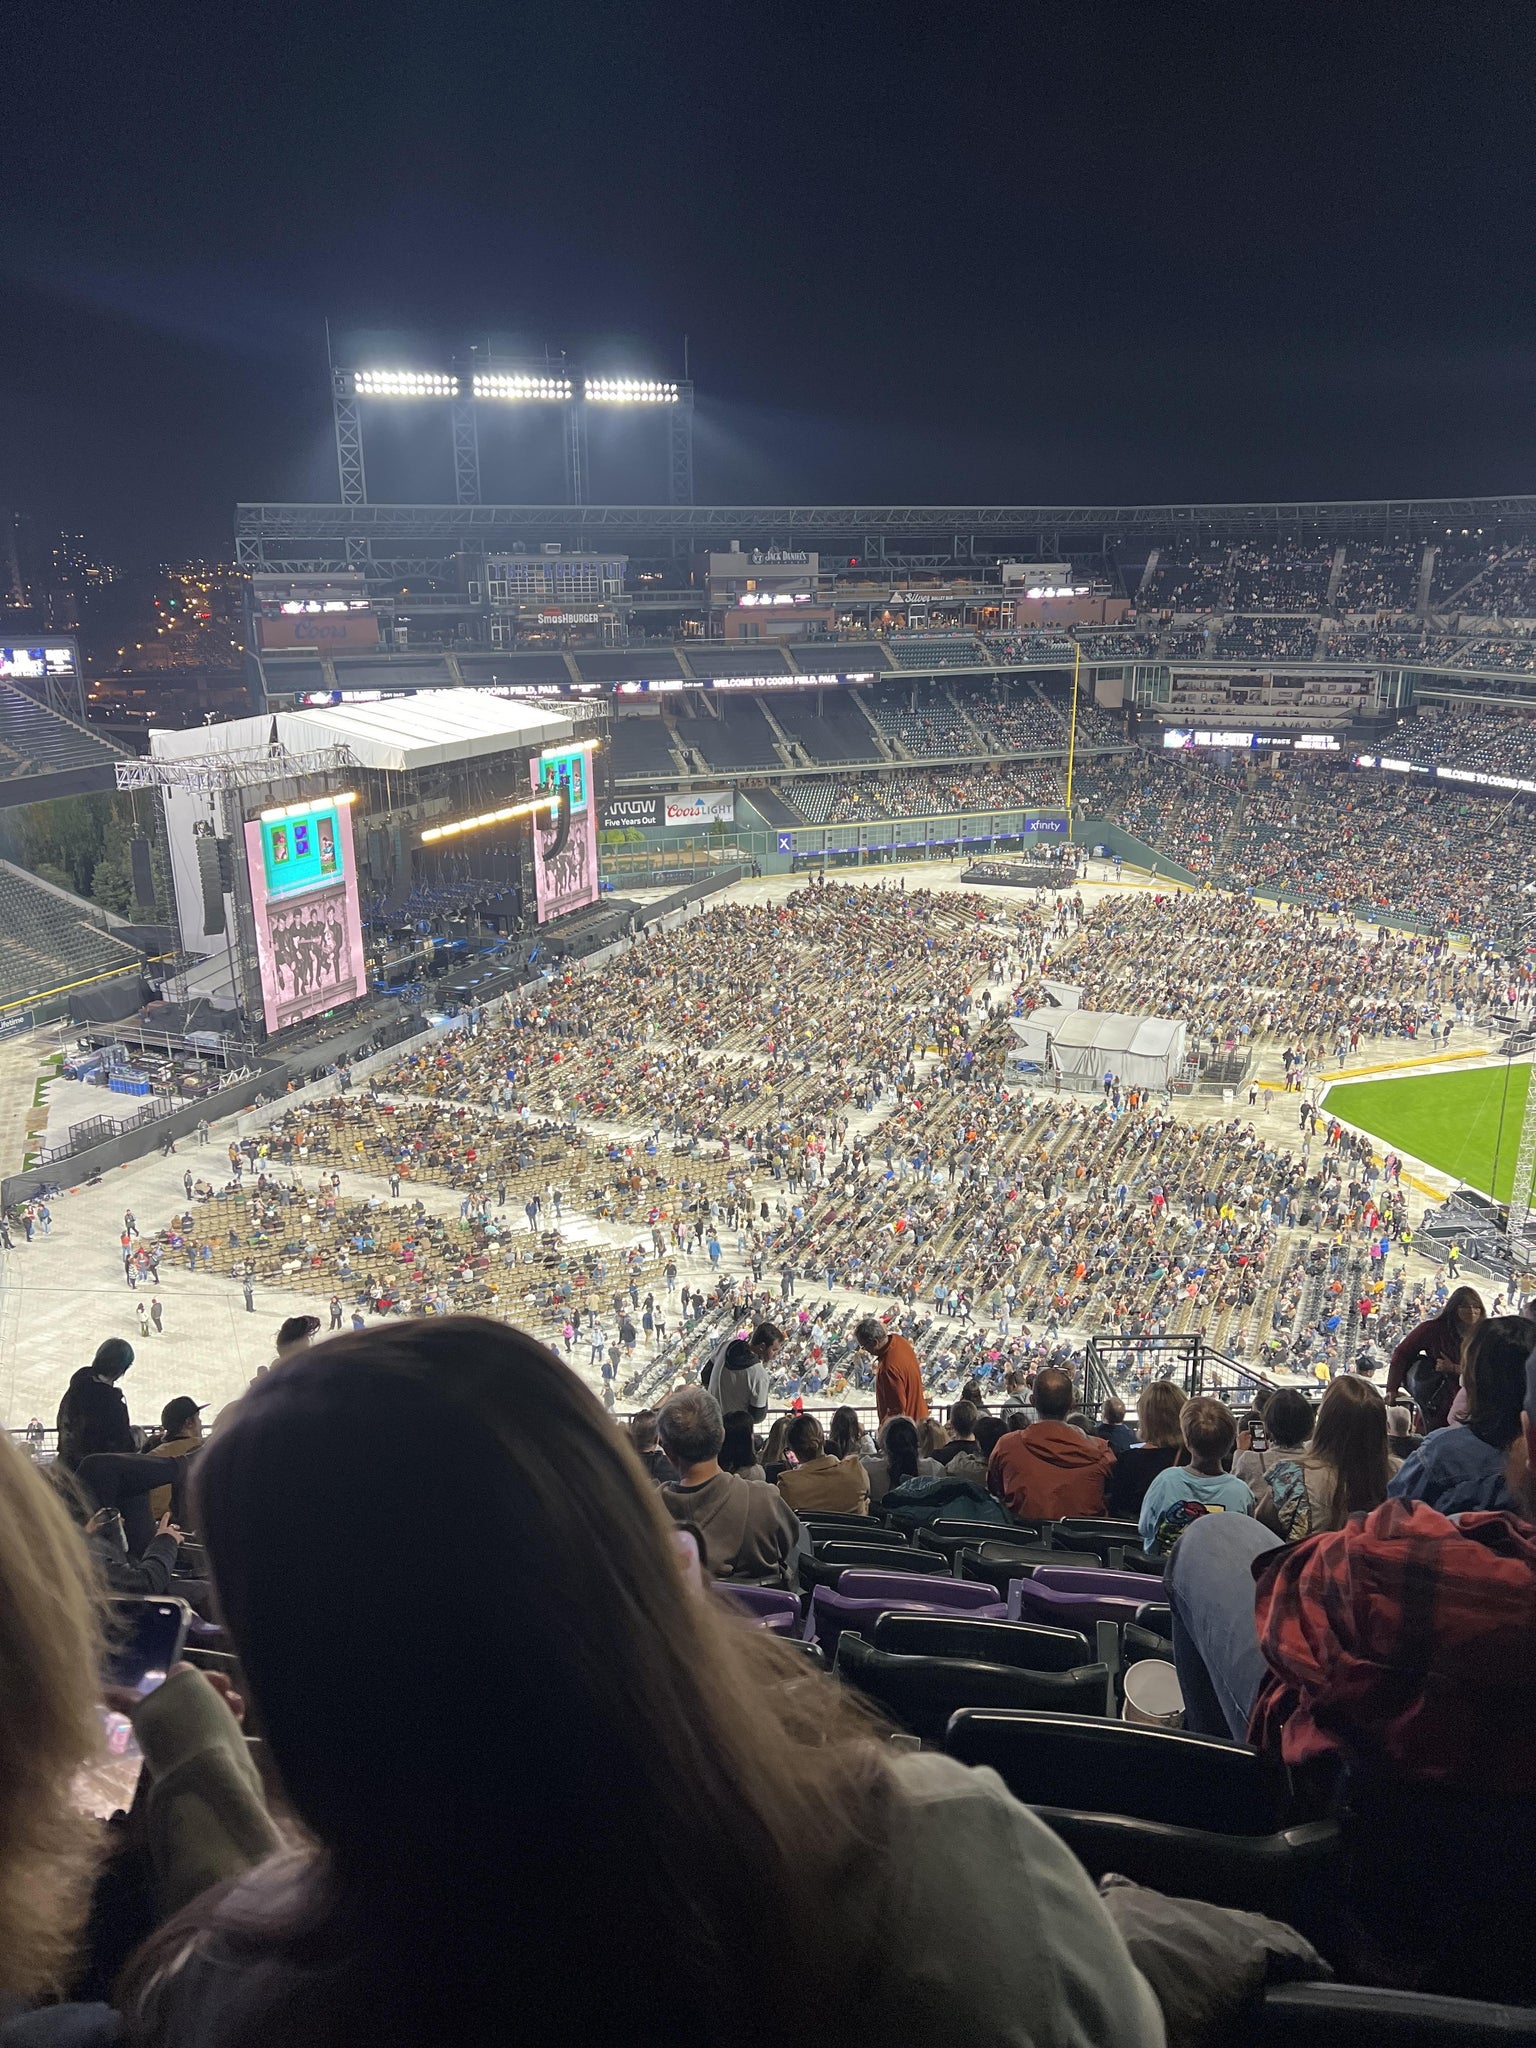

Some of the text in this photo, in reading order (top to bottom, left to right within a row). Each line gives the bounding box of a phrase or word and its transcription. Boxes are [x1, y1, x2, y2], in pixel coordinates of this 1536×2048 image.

[904, 592, 930, 603] Silver
[713, 678, 753, 688] WELCOME
[754, 678, 766, 686] TO
[766, 677, 794, 685] COORS
[794, 676, 818, 684] FIELD,
[818, 675, 838, 683] PAUL
[510, 686, 538, 695] FIELD,
[538, 685, 561, 694] PAUL
[1437, 768, 1476, 782] WELCOME
[1476, 774, 1488, 783] TO
[1488, 775, 1517, 788] COORS
[667, 804, 732, 818] Coors LIGHT
[604, 816, 656, 827] Five Years Out
[1030, 820, 1061, 832] xfinity
